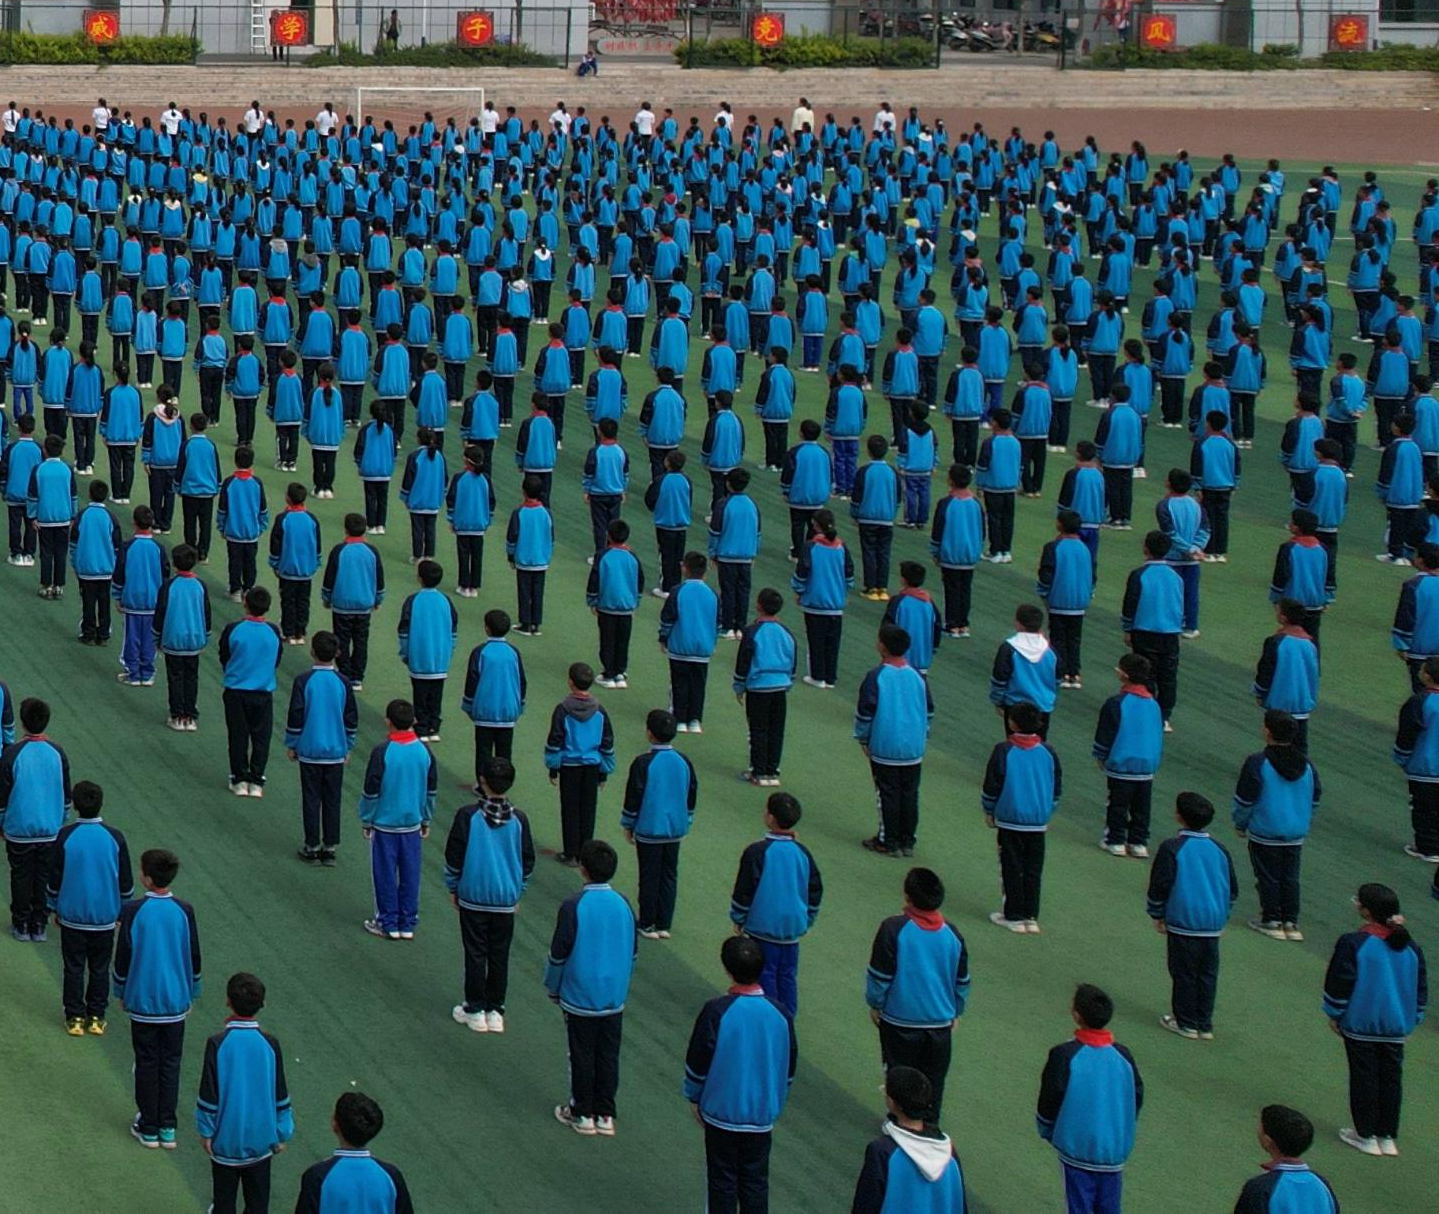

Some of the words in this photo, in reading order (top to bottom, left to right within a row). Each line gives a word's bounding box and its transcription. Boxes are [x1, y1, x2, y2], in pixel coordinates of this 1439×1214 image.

[92, 13, 113, 39] 威
[280, 14, 301, 38] 学
[466, 19, 486, 39] 子
[1147, 21, 1170, 42] 风
[1337, 24, 1359, 44] 流
